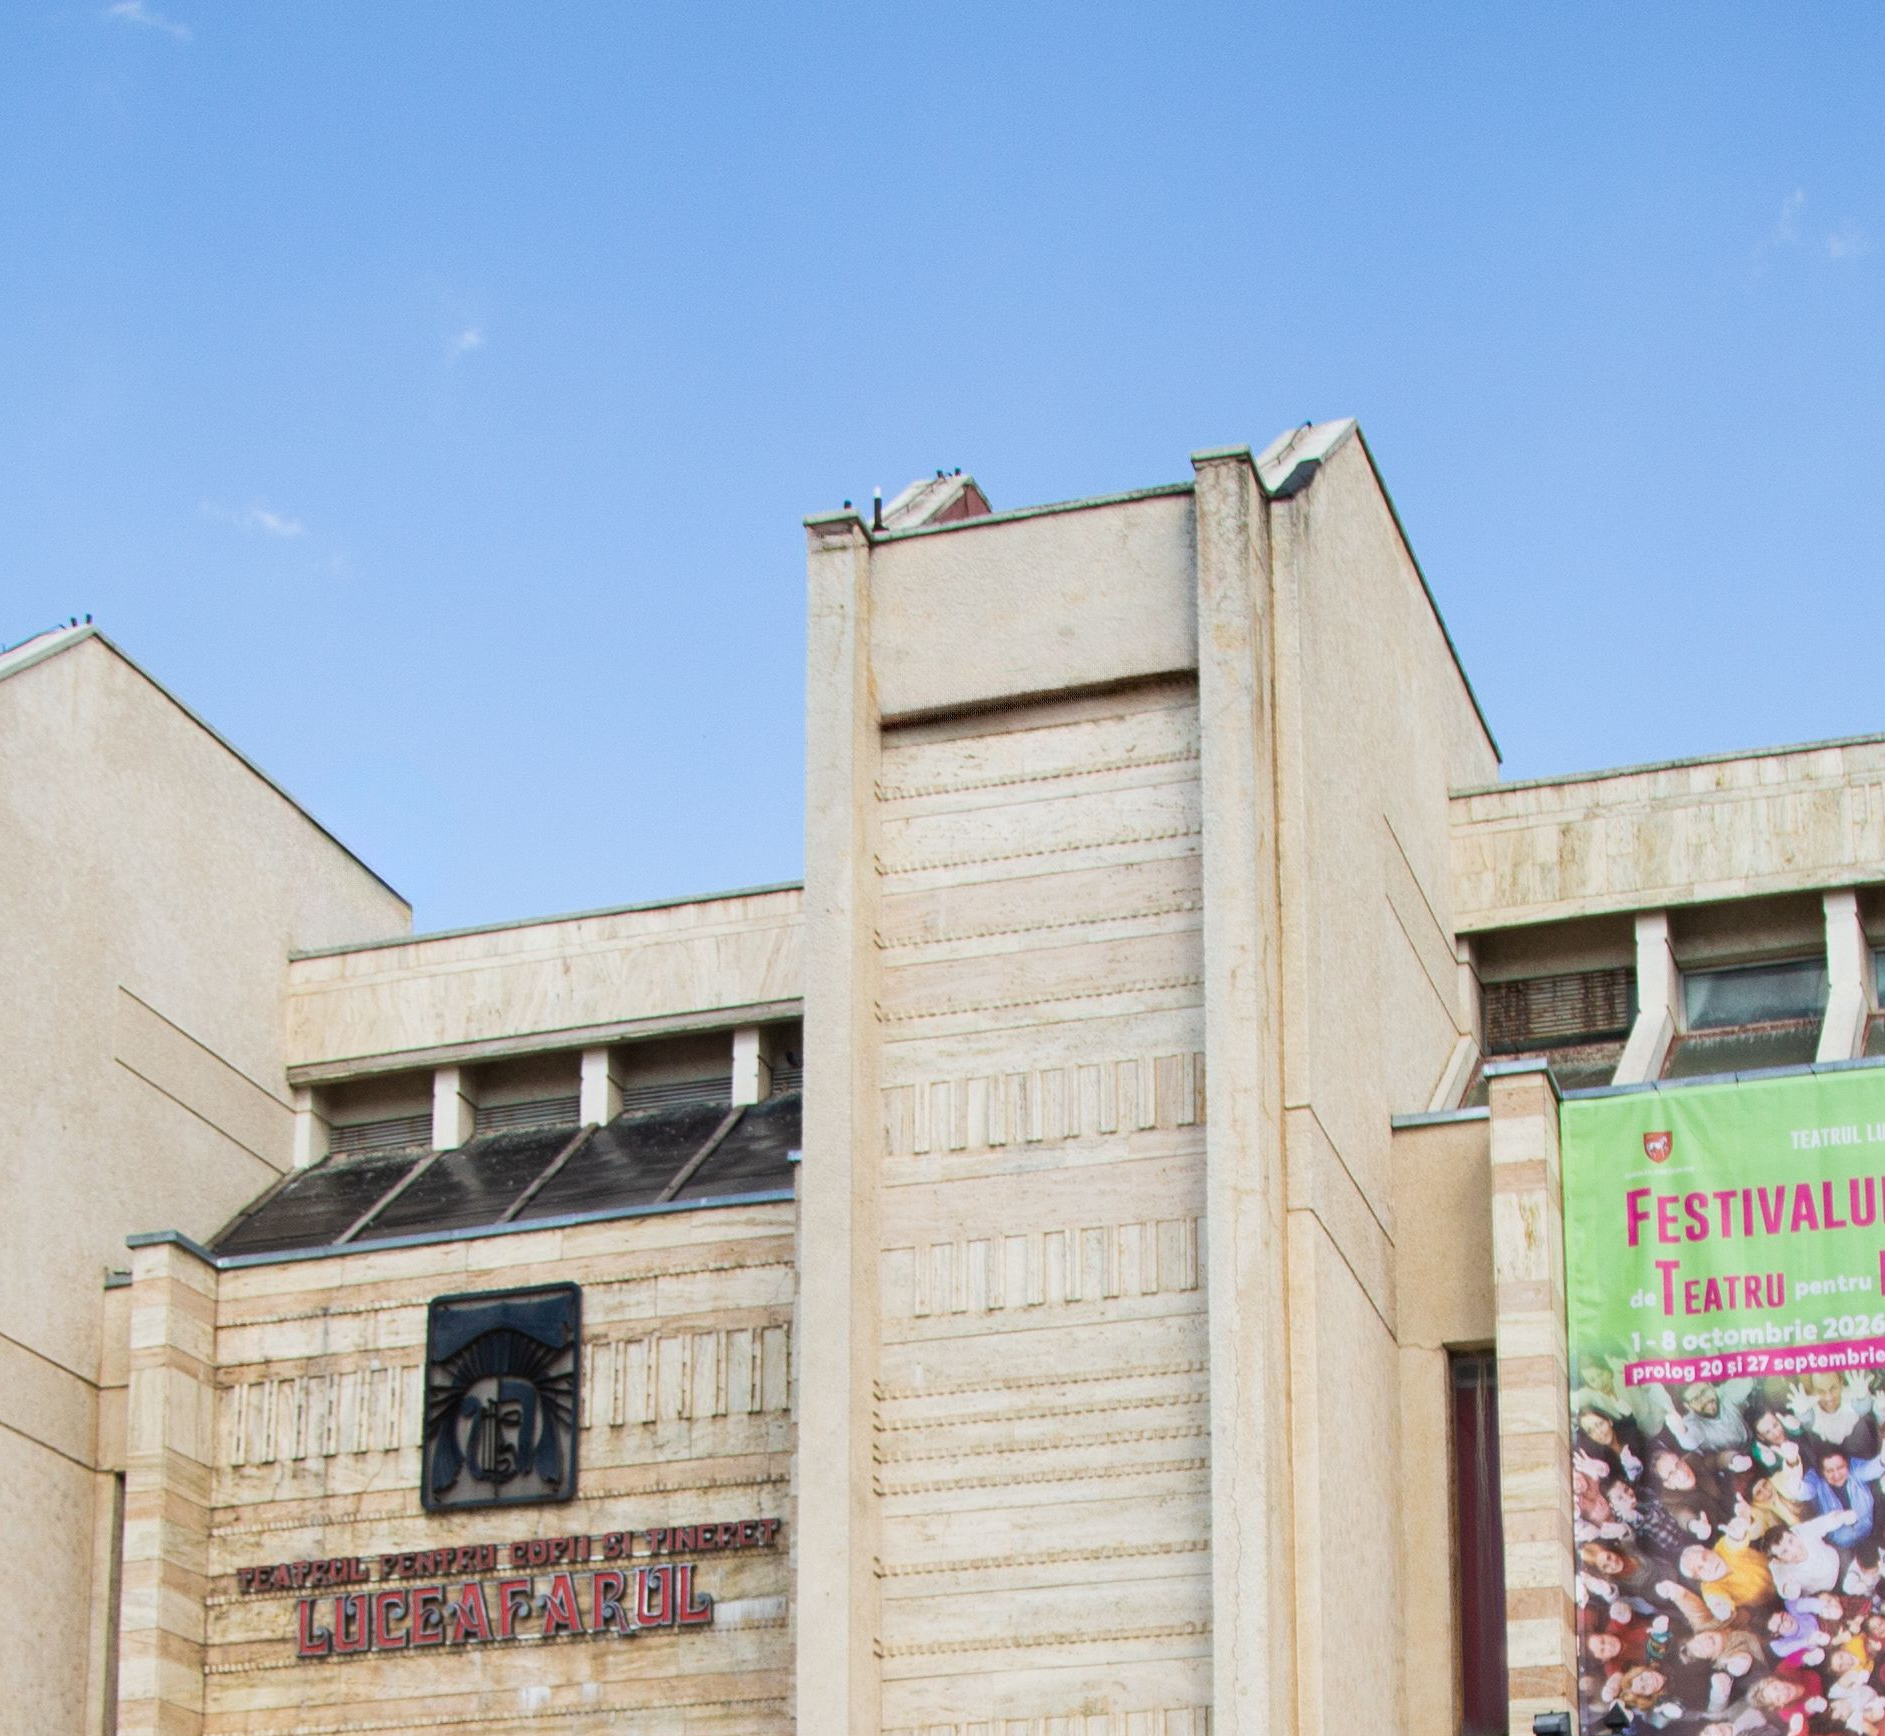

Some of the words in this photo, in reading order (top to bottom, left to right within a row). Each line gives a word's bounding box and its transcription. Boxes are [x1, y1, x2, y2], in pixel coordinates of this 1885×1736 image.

[1791, 1126, 1862, 1150] TEATRUL
[1630, 1288, 1657, 1309] de
[1655, 1260, 1785, 1316] TEATRU
[1794, 1274, 1872, 1299] pentru
[1630, 1331, 1641, 1352] 1
[1661, 1330, 1677, 1351] 8
[1682, 1319, 1818, 1350] octombrie
[1632, 1361, 1696, 1383] prolog
[1700, 1361, 1723, 1378] 20
[1727, 1357, 1743, 1378] și
[1747, 1355, 1769, 1372] 27
[237, 1556, 371, 1595] TEATRUL
[380, 1543, 497, 1579] PENTRU
[509, 1535, 592, 1567] COPII
[645, 1518, 781, 1552] TINERET
[297, 1562, 714, 1659] LUCEAFARUL
